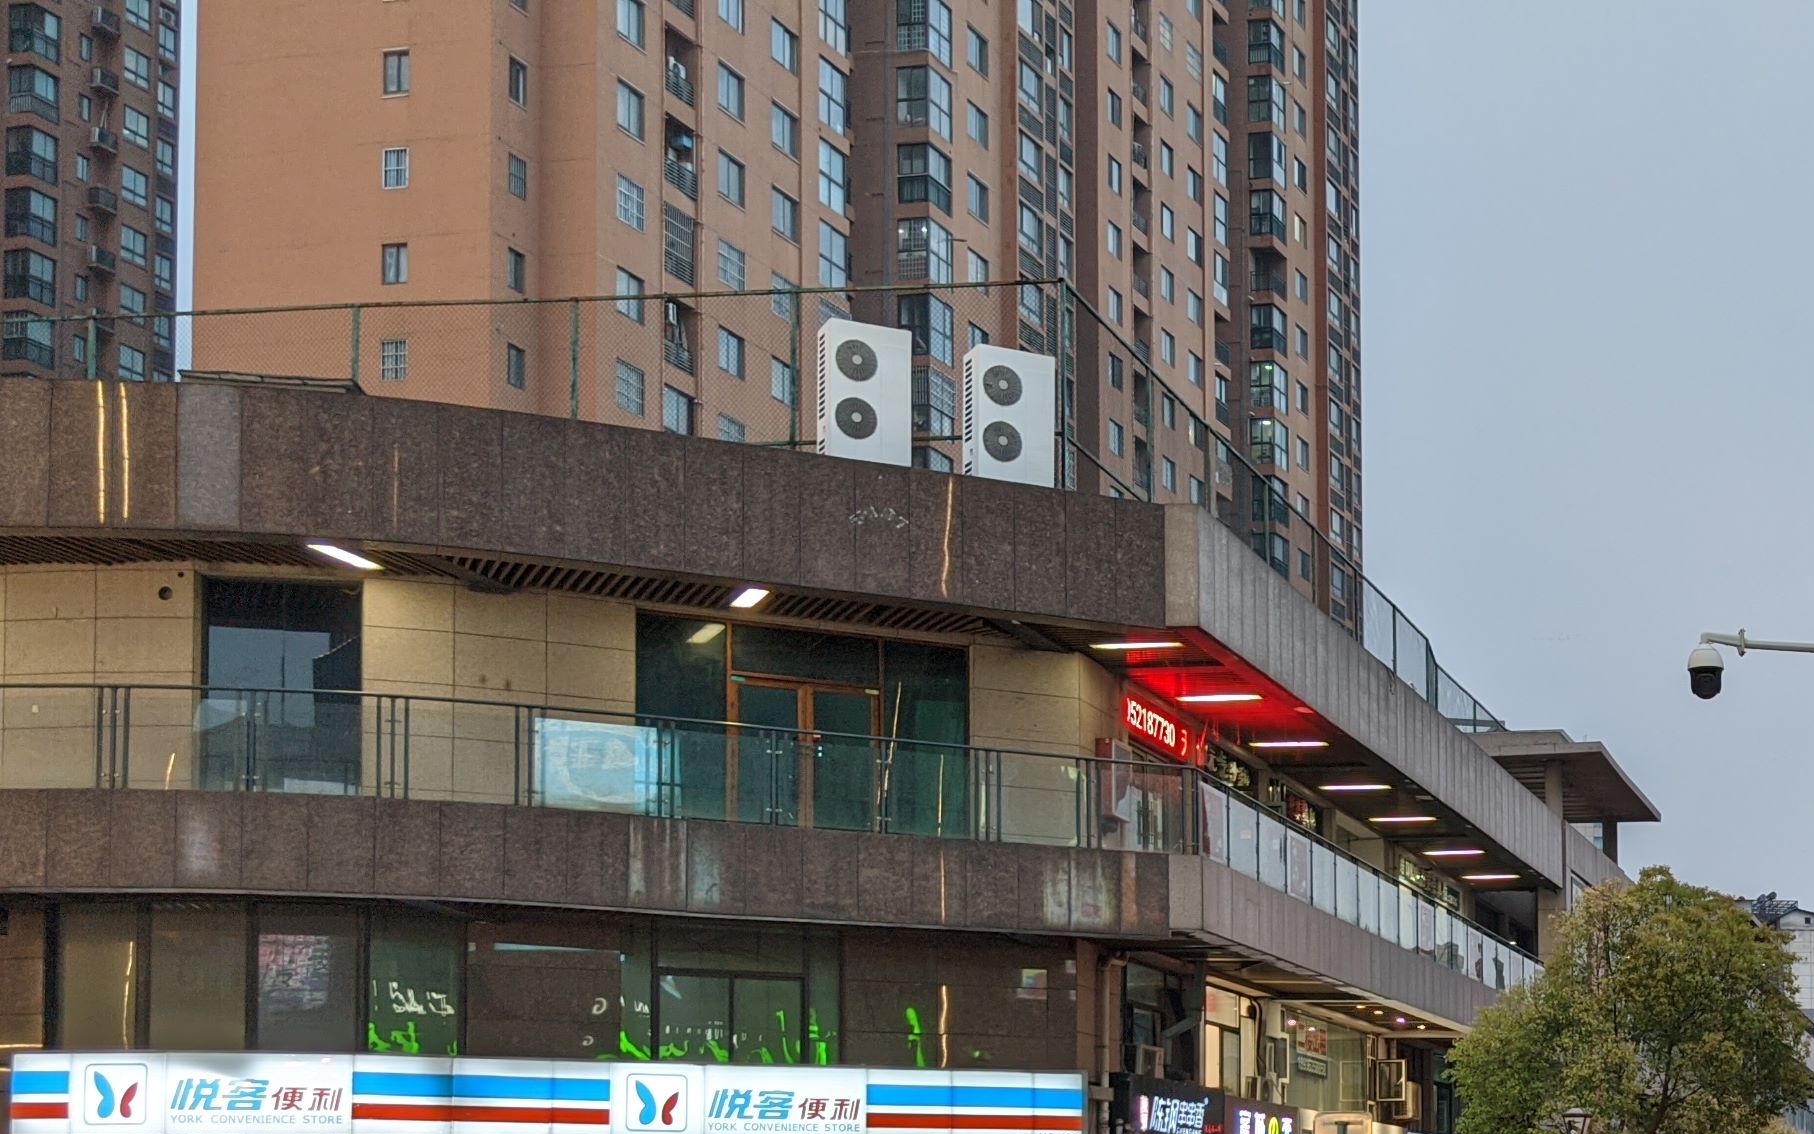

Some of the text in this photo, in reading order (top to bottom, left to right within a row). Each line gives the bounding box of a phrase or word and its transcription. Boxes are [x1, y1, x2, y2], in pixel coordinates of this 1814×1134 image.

[170, 1078, 344, 1111] 悦客便利
[708, 1088, 861, 1120] 悦客便利
[170, 1115, 343, 1124] YORK CONVENIENCE STORE
[708, 1122, 861, 1132] YORK CONVENIENCE STORE
